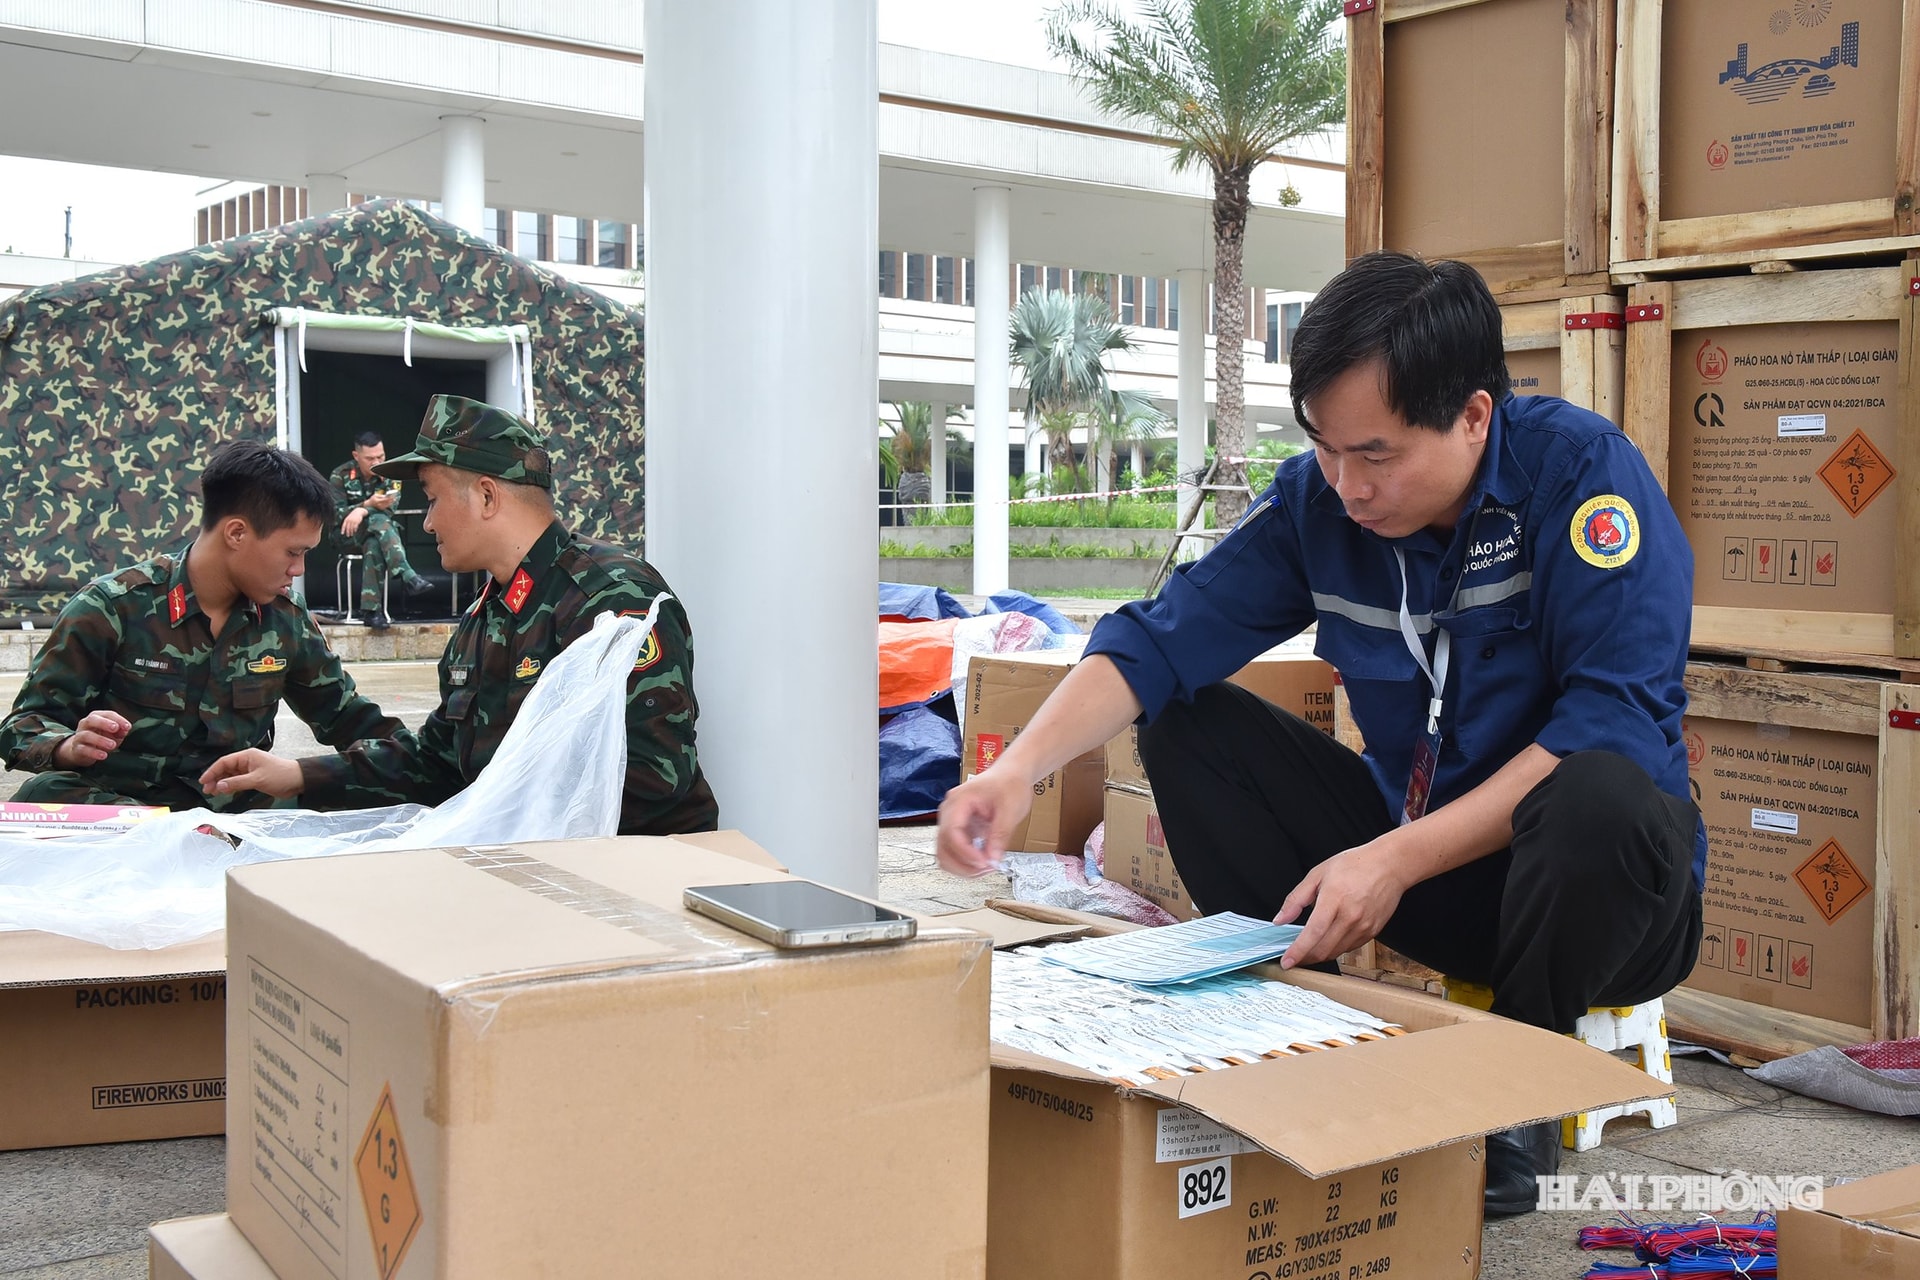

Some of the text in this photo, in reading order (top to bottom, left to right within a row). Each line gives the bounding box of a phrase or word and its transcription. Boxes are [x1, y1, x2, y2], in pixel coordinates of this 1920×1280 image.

[1734, 353, 1758, 366] PHÁO
[1760, 354, 1779, 366] HOA
[1810, 378, 1824, 386] HOA
[1743, 398, 1760, 410] SẢN
[1807, 399, 1831, 409] QCVN
[1832, 398, 1885, 408] 04:2021/BCA
[1752, 436, 1759, 444] 25
[1847, 473, 1865, 484] 1.3
[1850, 485, 1859, 495] G
[1852, 497, 1858, 507] 1
[1469, 541, 1493, 557] HÁO
[1604, 556, 1621, 564] Z121
[1304, 692, 1333, 705] ITEM
[974, 703, 980, 715] VN
[1711, 744, 1734, 758] PHÁO
[1736, 749, 1754, 760] HOA
[1777, 779, 1791, 788] HOA
[1720, 789, 1737, 801] SẢN
[1782, 800, 1806, 811] QCVN
[1808, 804, 1859, 819] 04:2021/BCA
[1822, 879, 1839, 893] 1.3
[1825, 892, 1834, 902] G
[1827, 903, 1832, 914] 1
[76, 983, 180, 1009] PACKING:
[98, 1084, 188, 1106] FIREWORKS
[1007, 1081, 1094, 1123] 49F075/048/25
[1162, 1114, 1179, 1123] Item
[1162, 1123, 1200, 1134] Single row
[1162, 1136, 1190, 1145] 13shots
[1197, 1134, 1217, 1143] shape
[375, 1128, 398, 1180] 1.3
[1183, 1165, 1227, 1210] 892
[1328, 1167, 1399, 1200] 23 KG
[381, 1193, 390, 1224] G
[1249, 1197, 1279, 1219] G.W:
[1248, 1189, 1397, 1243] N.W: 22 KG
[1246, 1211, 1397, 1267] MEAS: 790X415X240 MM
[382, 1243, 387, 1273] 1
[1276, 1248, 1342, 1280] 4G/Y30/S/25
[1349, 1265, 1363, 1280] PI:
[1366, 1256, 1391, 1278] 2489
